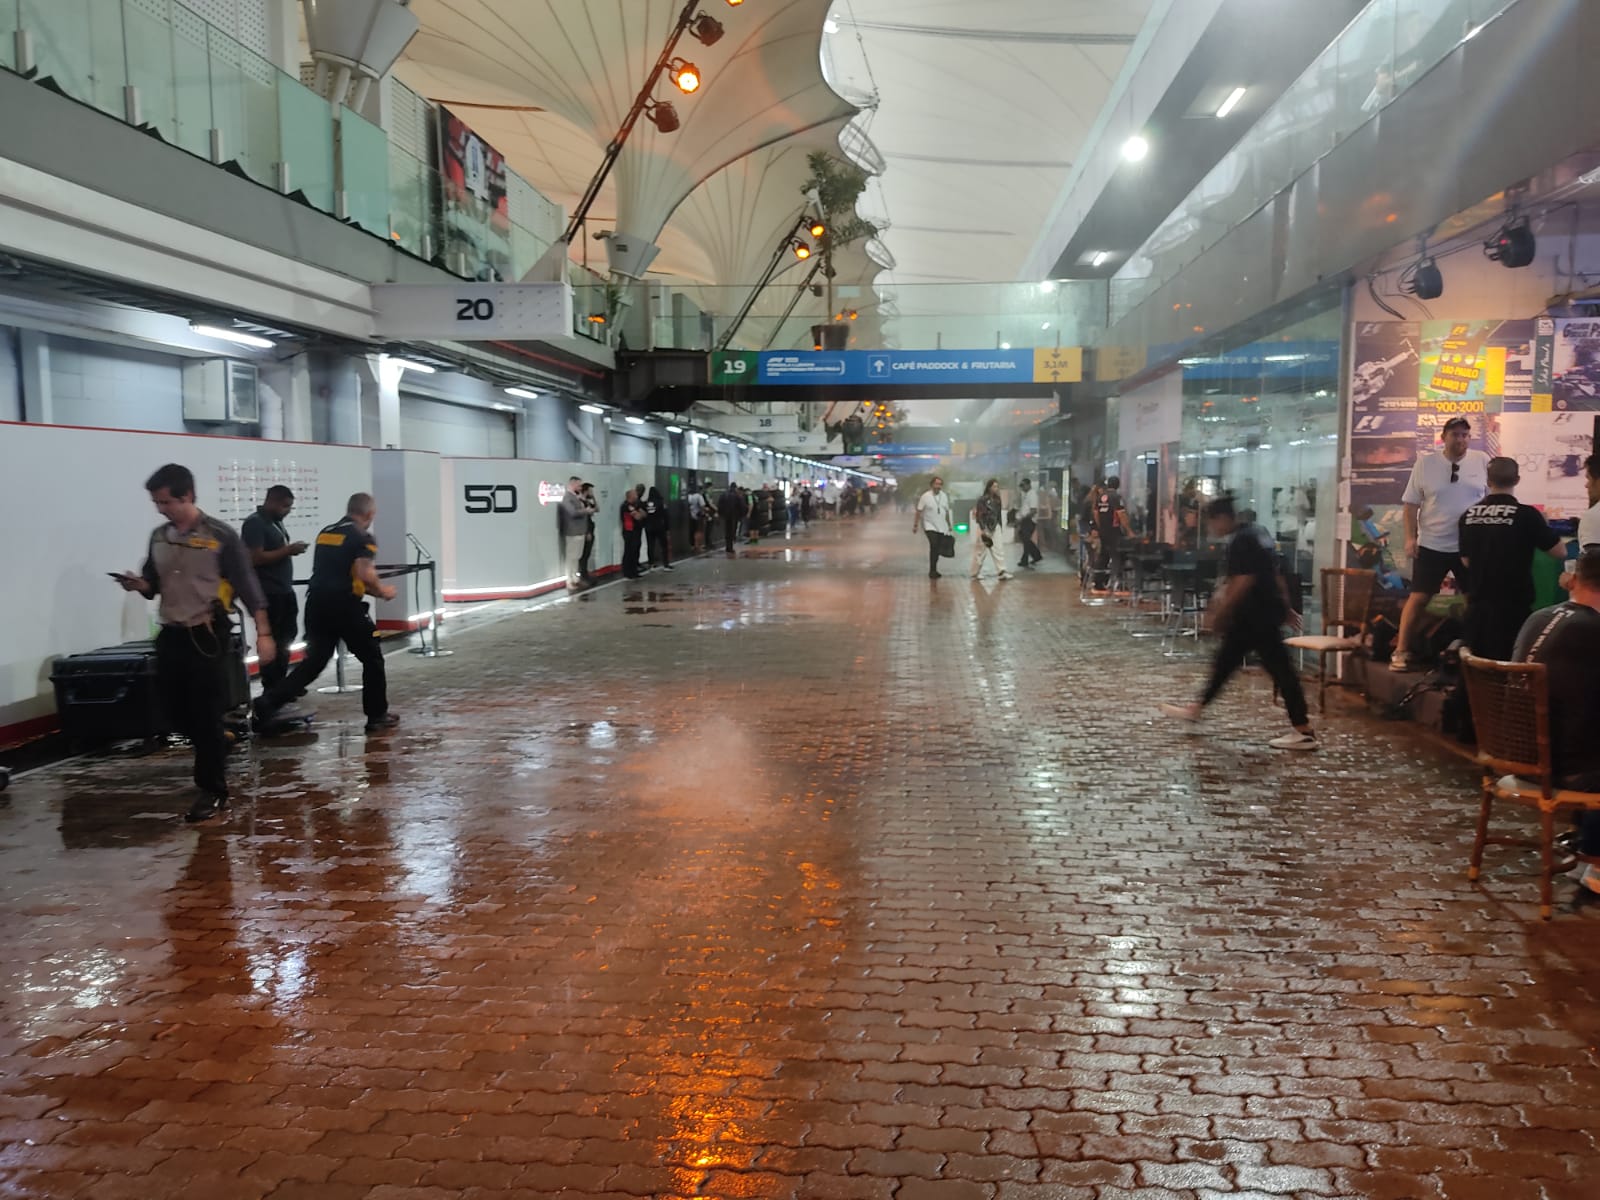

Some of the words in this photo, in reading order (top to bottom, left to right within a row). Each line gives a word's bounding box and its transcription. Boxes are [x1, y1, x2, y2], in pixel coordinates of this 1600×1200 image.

[456, 298, 494, 321] 20
[723, 359, 747, 374] 19
[892, 360, 915, 370] CAFÉ
[917, 361, 959, 370] PADDOCK
[1435, 401, 1484, 413] 900-2001
[759, 418, 772, 427] 18
[1355, 415, 1384, 430] F1
[464, 485, 517, 513] 50
[1466, 504, 1518, 517] STAFF
